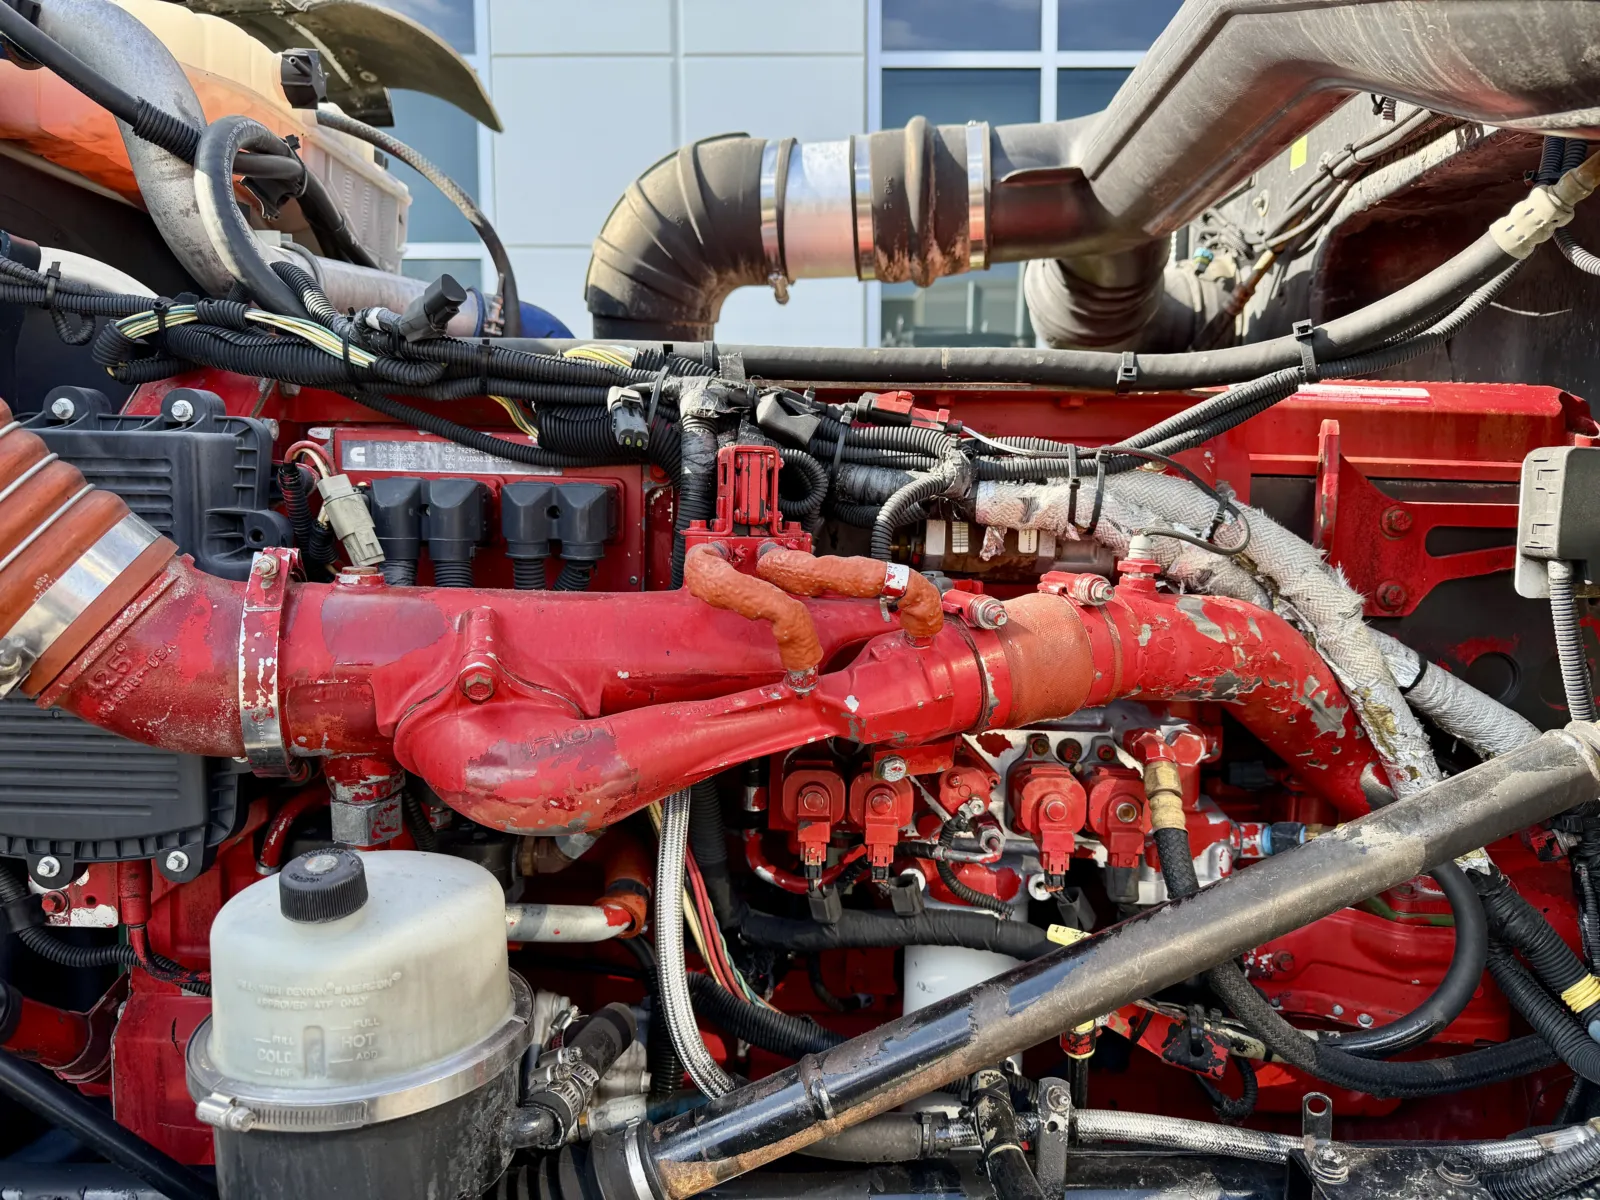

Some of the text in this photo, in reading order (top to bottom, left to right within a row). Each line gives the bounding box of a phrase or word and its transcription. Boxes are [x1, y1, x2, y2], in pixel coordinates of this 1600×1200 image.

[257, 995, 369, 1011] APPROVED ATF ONLY
[353, 1017, 380, 1028] FULL
[272, 1034, 295, 1046] FULL
[340, 1032, 376, 1049] HOT
[257, 1048, 292, 1064] COLD
[355, 1050, 378, 1061] ADD
